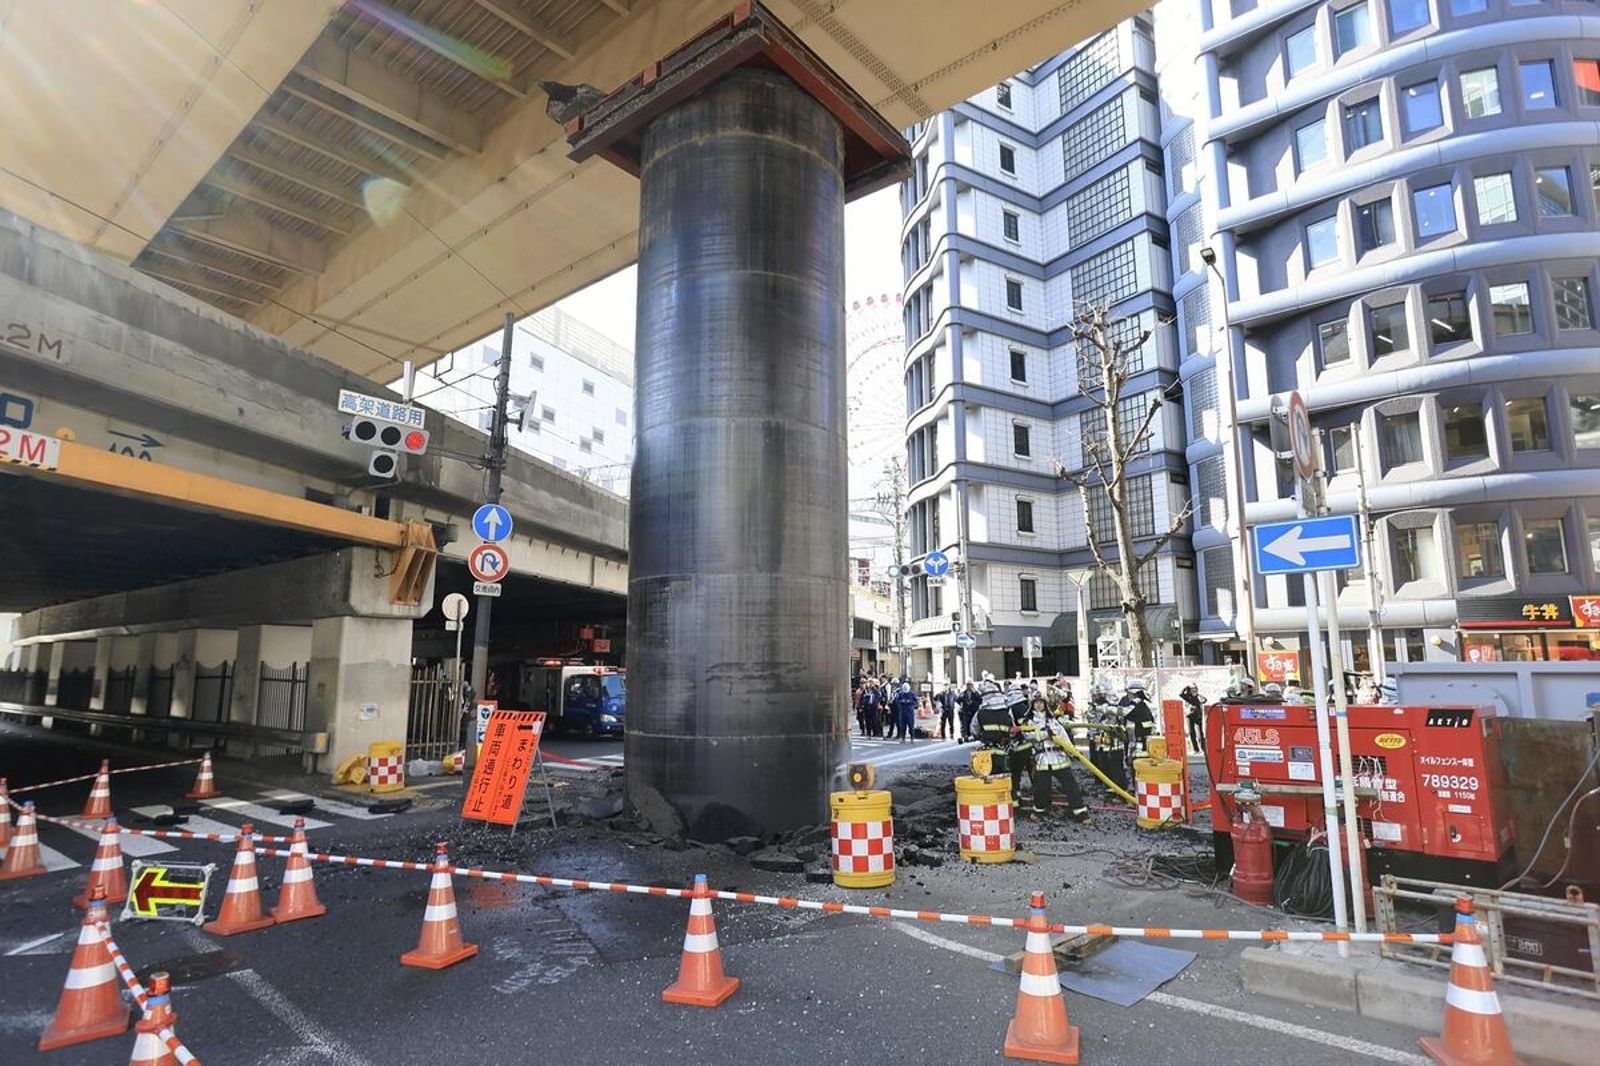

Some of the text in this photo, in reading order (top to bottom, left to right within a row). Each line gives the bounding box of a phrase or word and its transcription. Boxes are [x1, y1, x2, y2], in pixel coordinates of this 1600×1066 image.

[341, 393, 422, 426] 高架道路用
[1522, 603, 1559, 620] 牛丼
[471, 722, 506, 813] 車両通行止
[500, 738, 528, 811] まわり道
[1421, 773, 1478, 790] 789329
